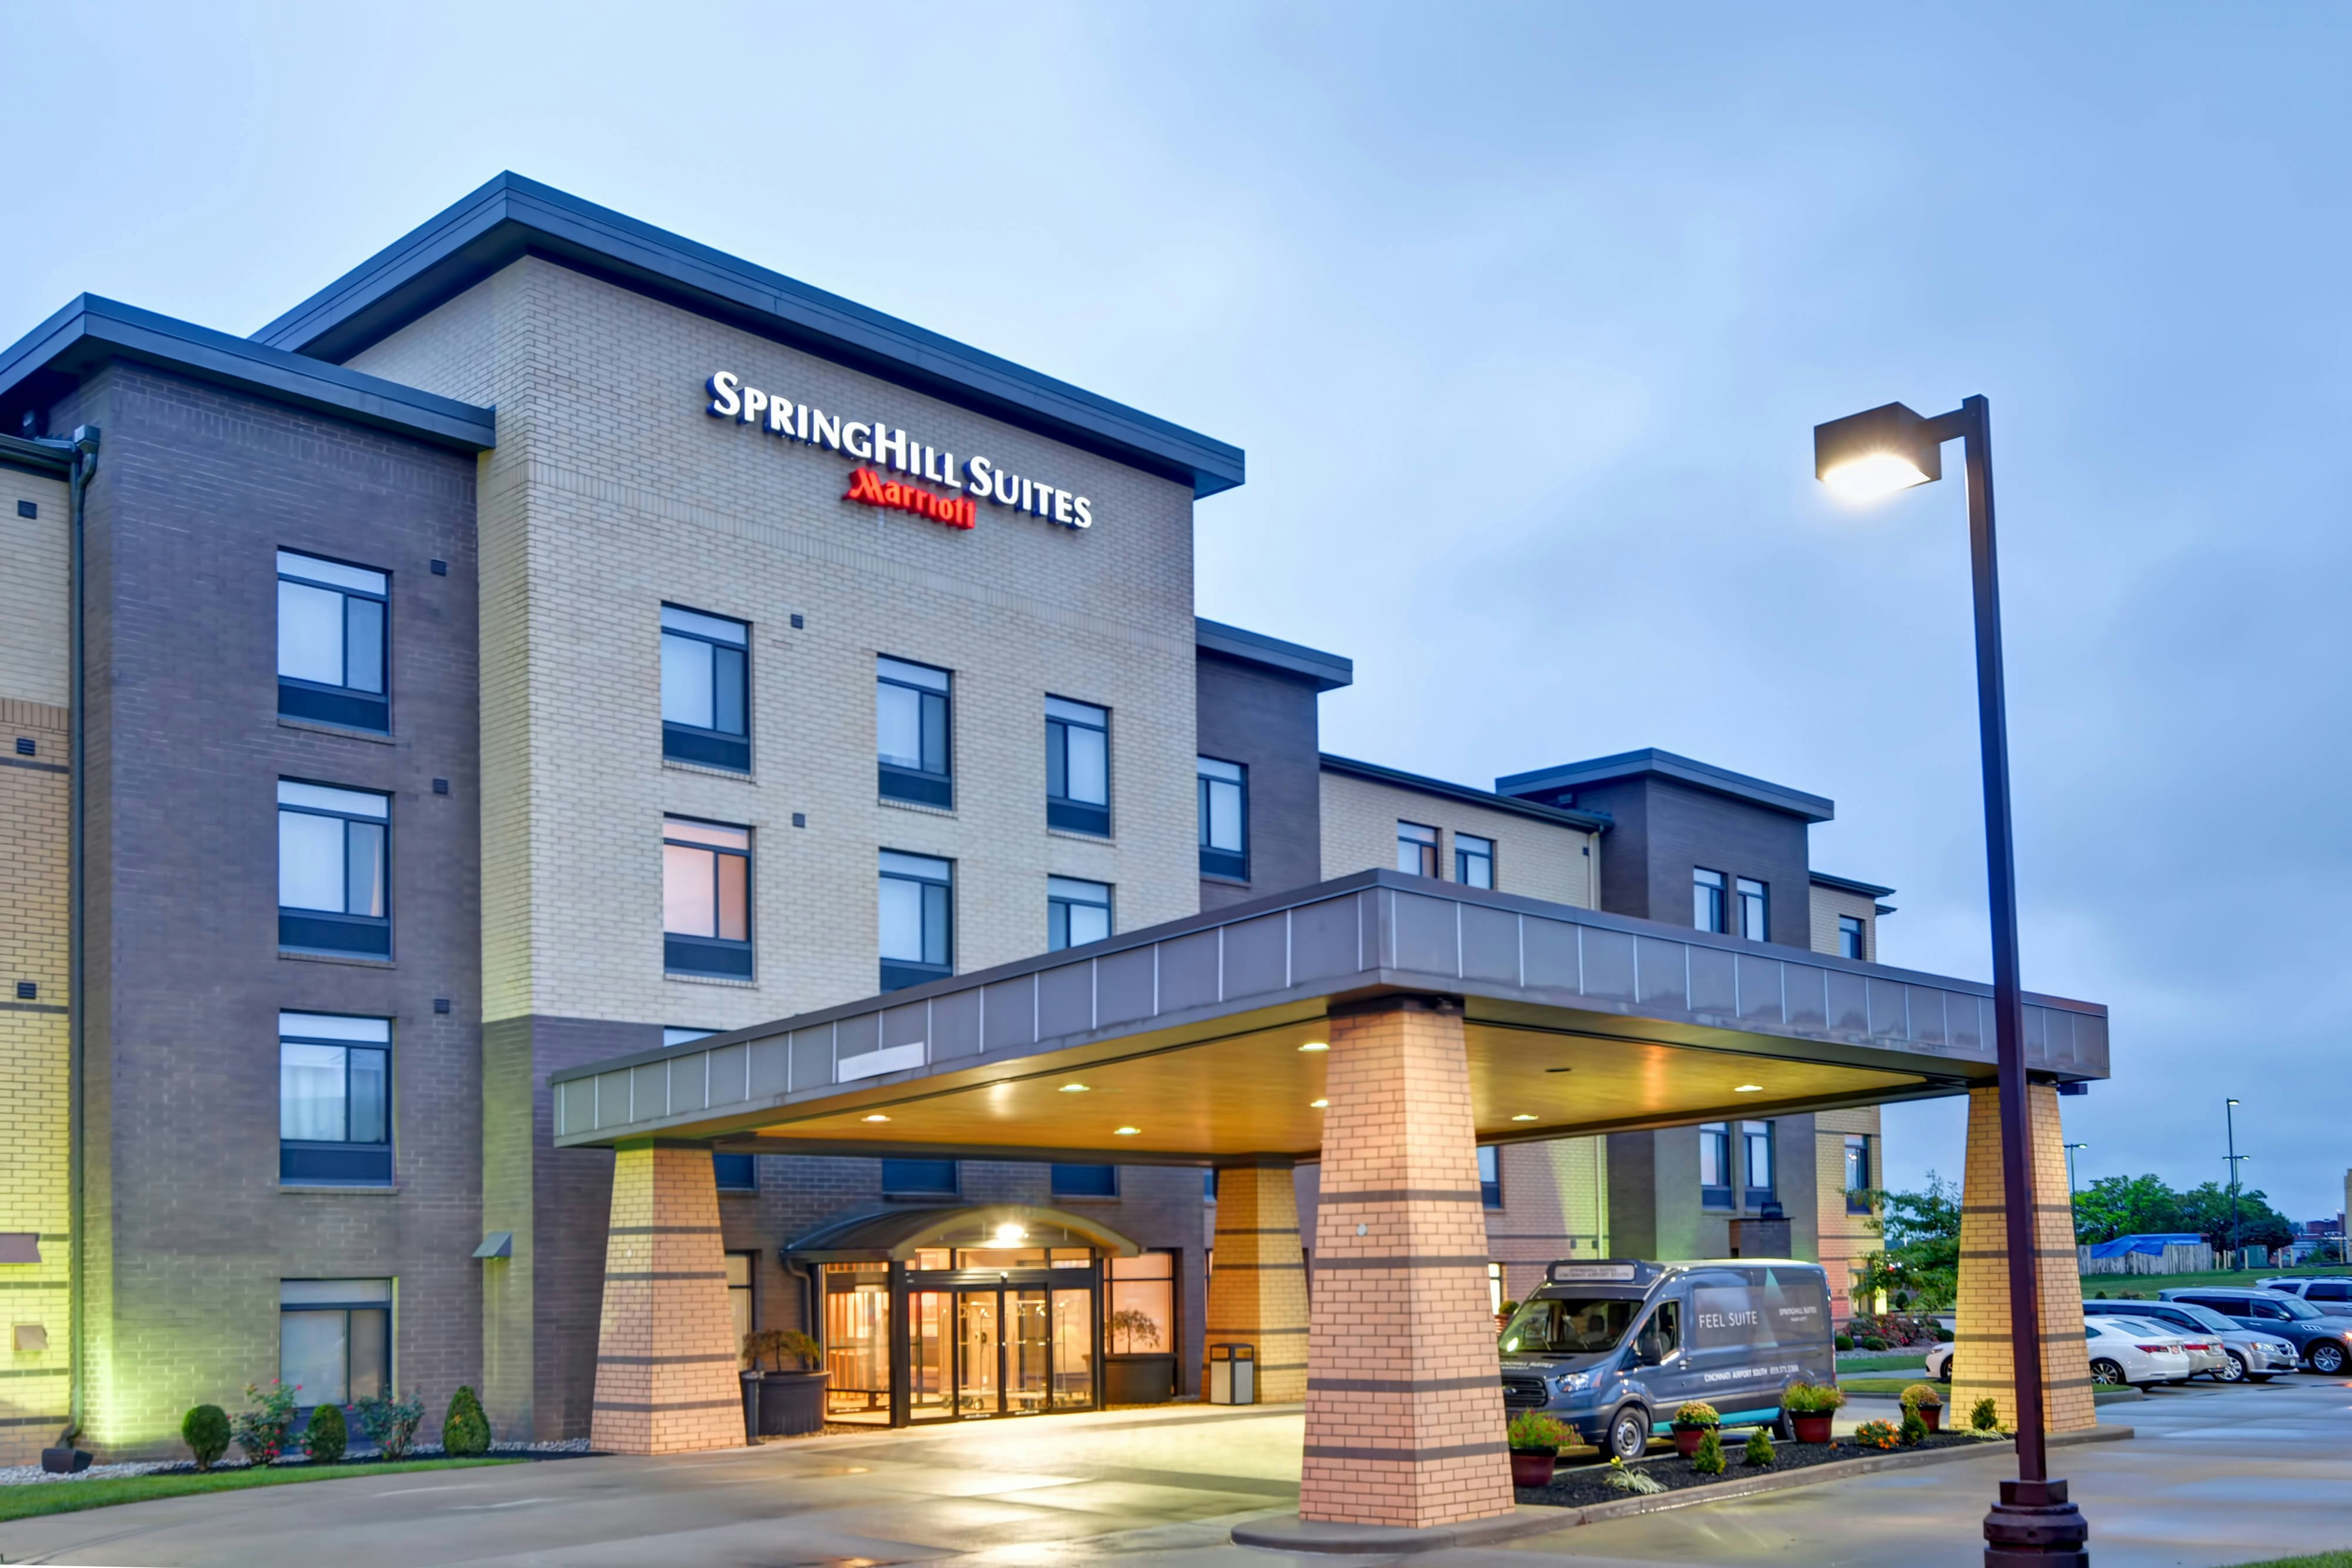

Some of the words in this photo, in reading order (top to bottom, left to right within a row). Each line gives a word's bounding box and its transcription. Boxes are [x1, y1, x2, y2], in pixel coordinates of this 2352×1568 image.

[707, 371, 961, 488] SPRINGHILL
[964, 456, 1092, 529] SUITES
[846, 467, 975, 529] Marriott
[1699, 1313, 1726, 1328] FEEL
[1729, 1311, 1758, 1326] SUITE
[1704, 1372, 1731, 1382] CINCINNATI
[1732, 1369, 1752, 1379] AIRPORT
[1752, 1368, 1768, 1377] SOUTH
